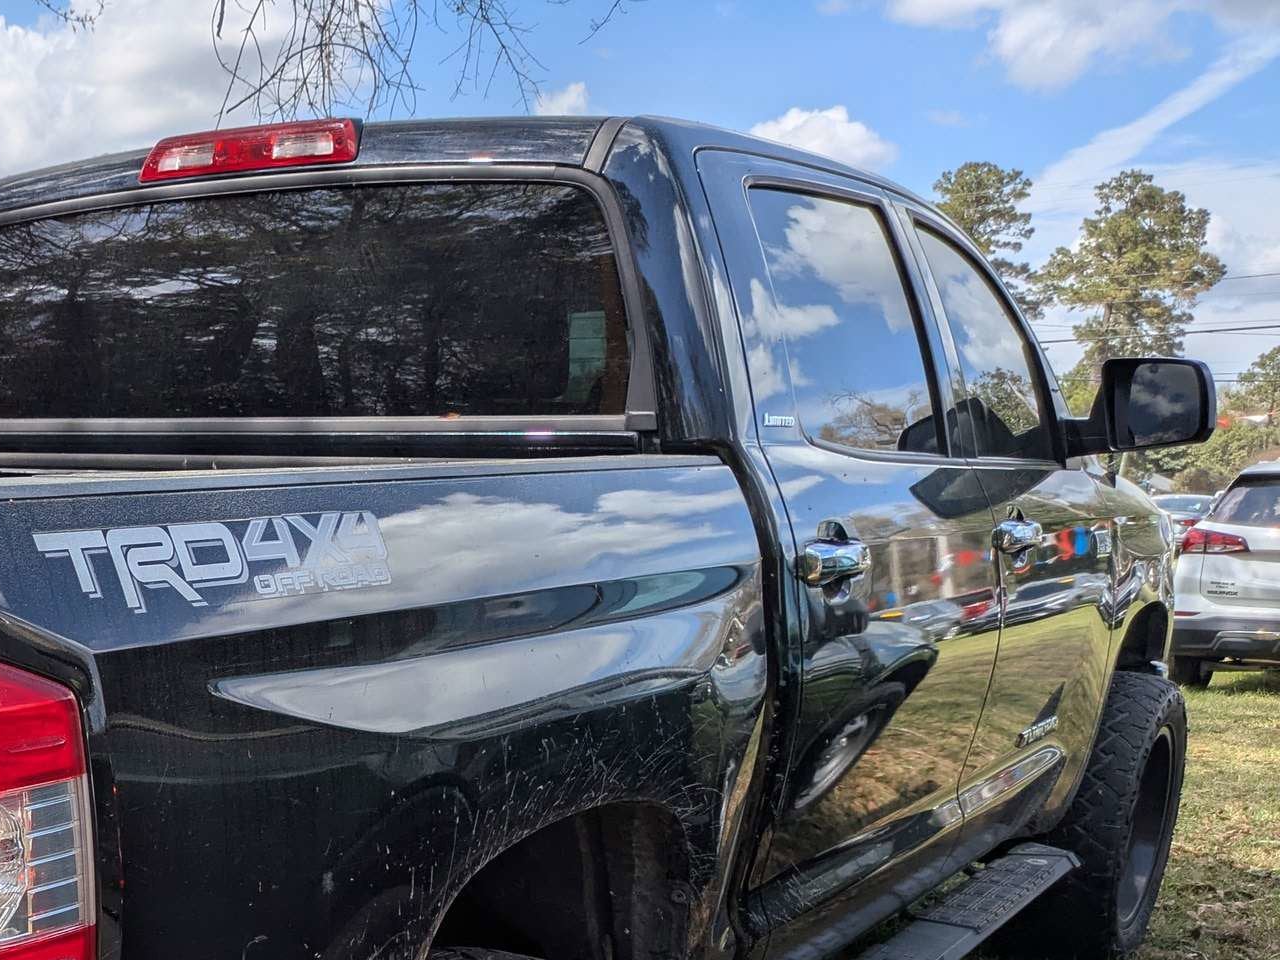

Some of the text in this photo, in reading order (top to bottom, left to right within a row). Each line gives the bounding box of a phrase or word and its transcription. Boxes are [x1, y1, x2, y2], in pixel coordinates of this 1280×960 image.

[32, 521, 249, 614] TRD
[254, 562, 392, 598] OFF ROAD
